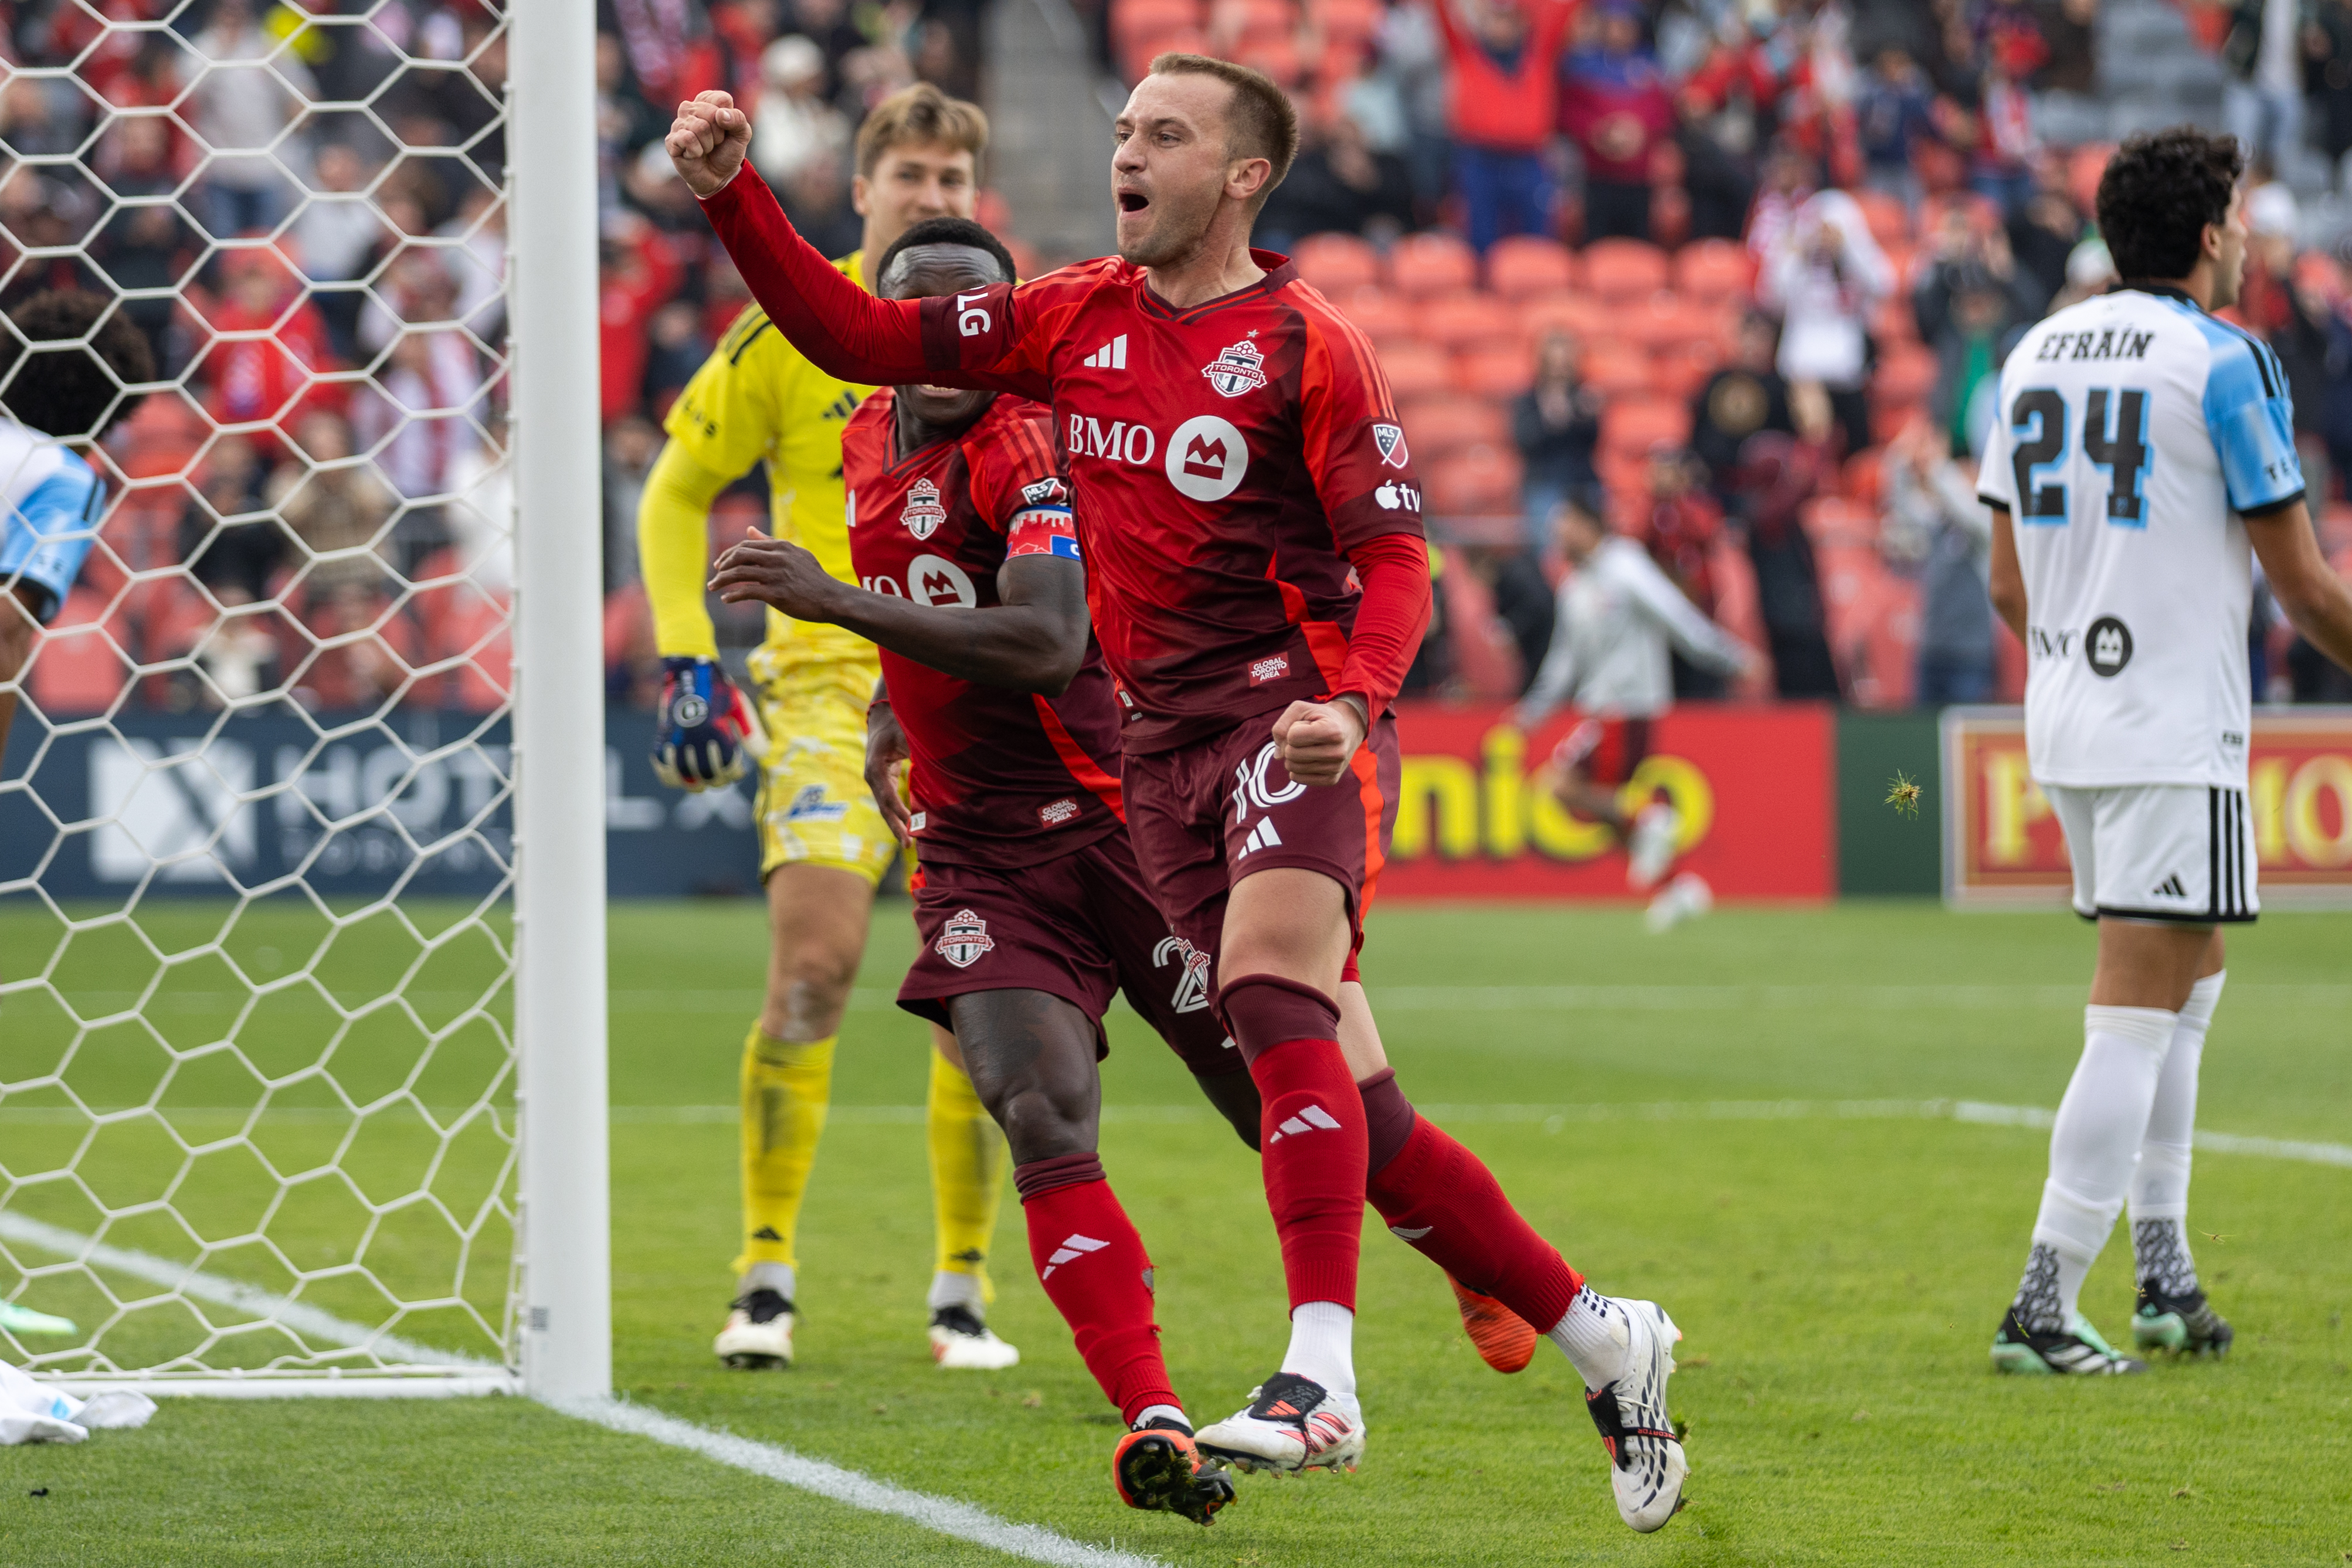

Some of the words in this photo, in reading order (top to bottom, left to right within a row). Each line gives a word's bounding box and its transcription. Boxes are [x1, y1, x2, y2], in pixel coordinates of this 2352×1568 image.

[958, 292, 991, 337] LG
[1214, 364, 1258, 378] TORONTO
[1068, 413, 1155, 465] BMO
[1377, 427, 1395, 438] MLS
[2011, 388, 2154, 529] 24
[1026, 484, 1048, 498] MLS
[1399, 483, 1420, 513] tv
[1251, 661, 1287, 677] TORONTO
[1253, 657, 1284, 670] GLOBAL
[1260, 670, 1280, 681] AREA
[273, 743, 666, 830] HOTL
[1041, 803, 1077, 822] TORONTO
[1043, 799, 1073, 814] GLOBAL
[1052, 812, 1073, 824] AREA
[943, 935, 985, 945] TORONTO
